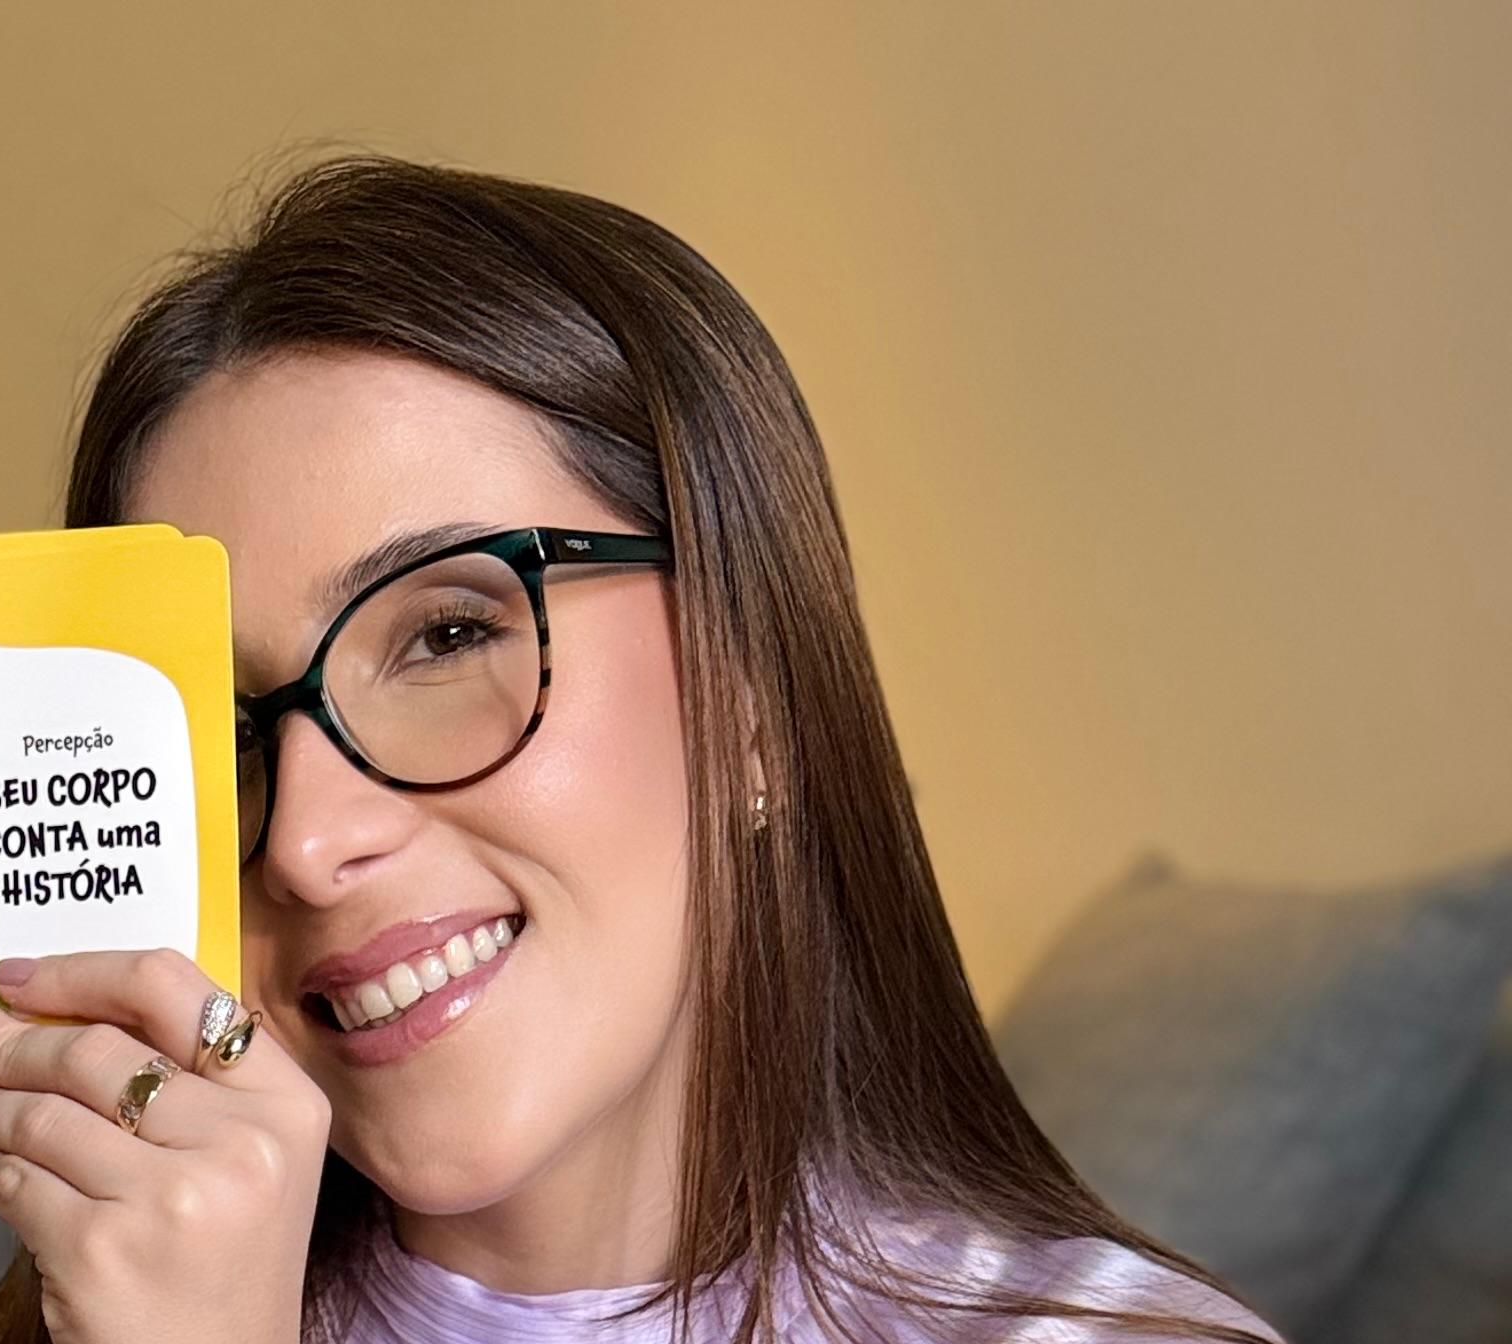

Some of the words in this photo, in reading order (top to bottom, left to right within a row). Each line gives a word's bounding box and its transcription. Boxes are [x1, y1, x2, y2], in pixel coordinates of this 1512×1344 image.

[23, 727, 114, 757] Percepção
[47, 767, 157, 808] CORPO
[97, 820, 161, 849] uma
[1, 858, 144, 906] HISTÓRIA
